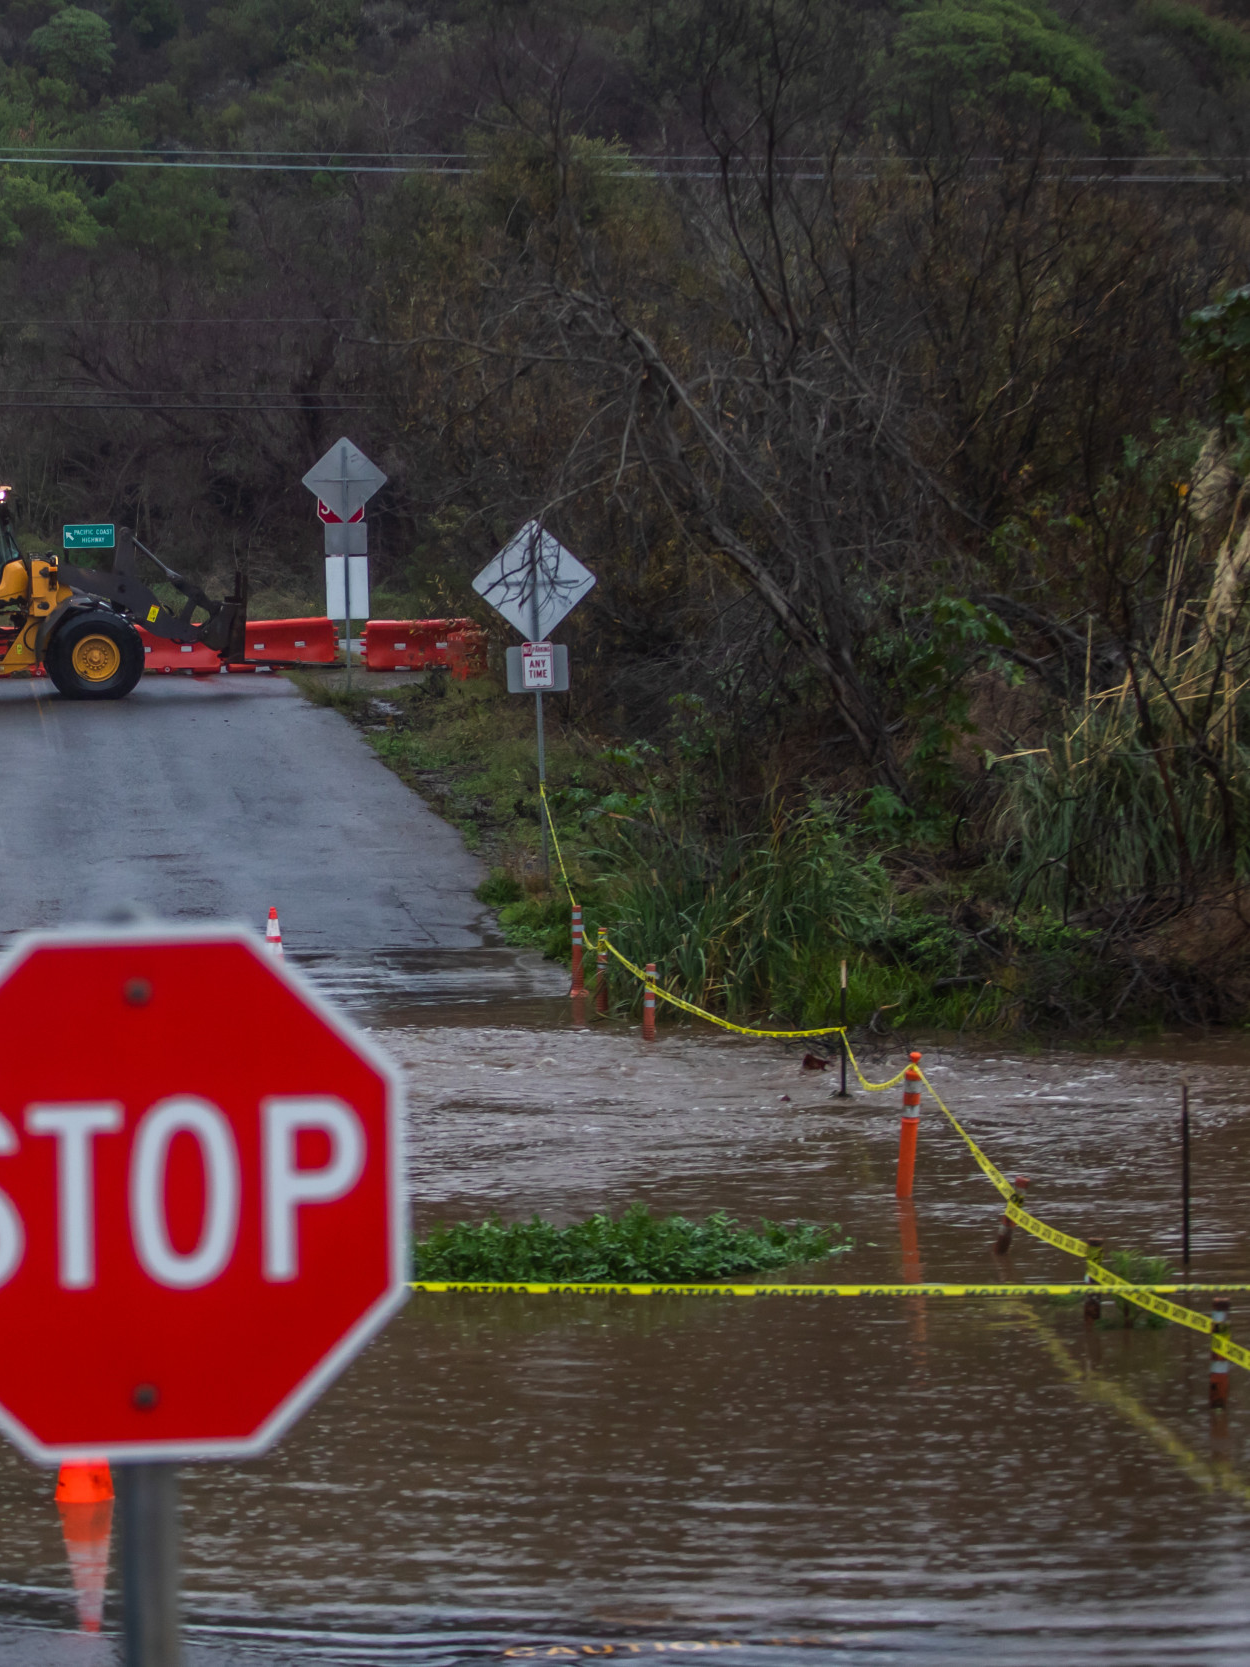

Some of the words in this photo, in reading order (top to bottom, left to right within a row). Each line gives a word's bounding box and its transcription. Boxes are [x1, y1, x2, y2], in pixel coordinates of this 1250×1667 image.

[529, 660, 546, 668] ANY
[529, 669, 548, 679] TIME
[503, 1639, 741, 1657] CAUTION
